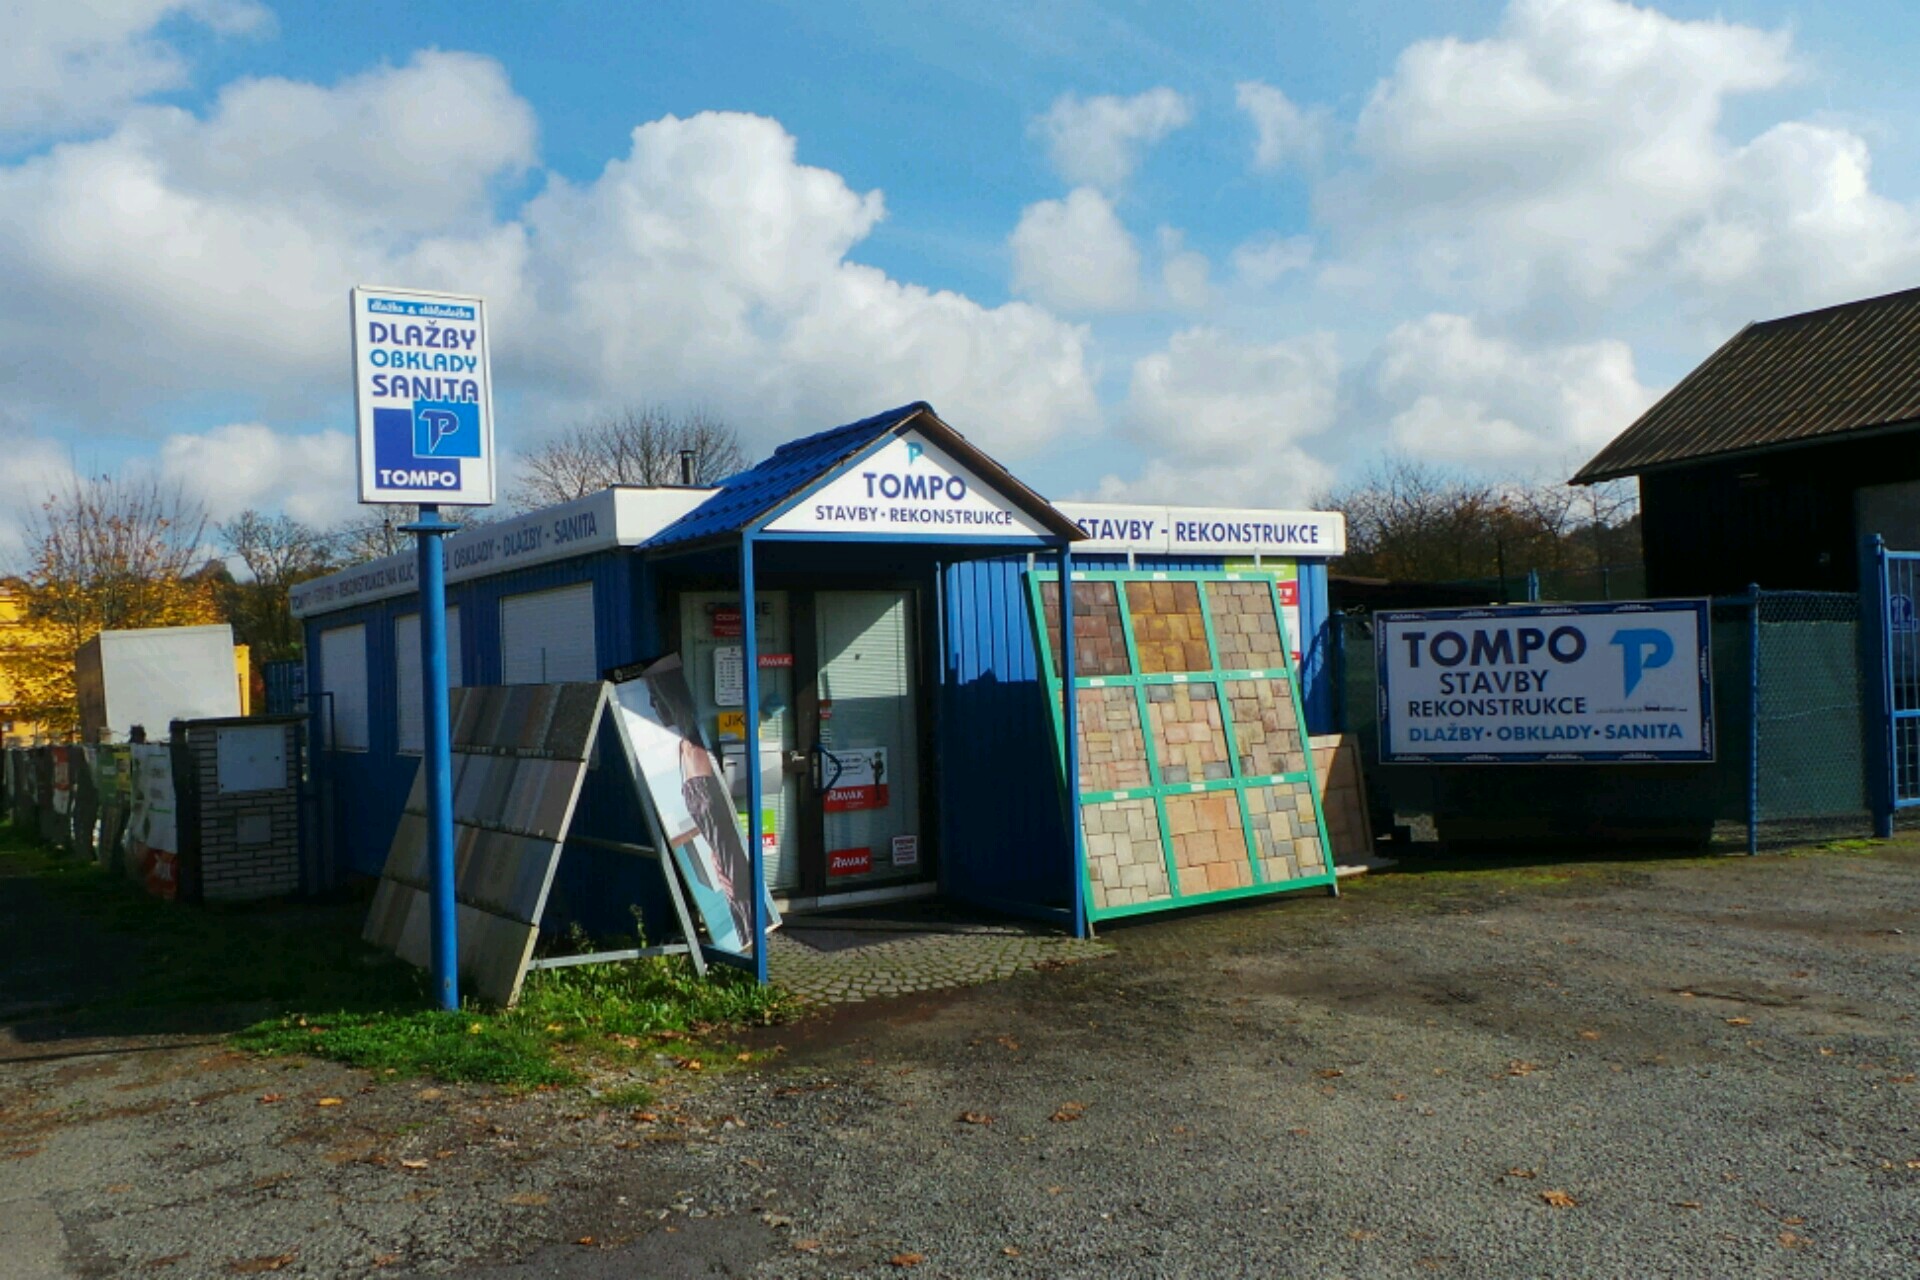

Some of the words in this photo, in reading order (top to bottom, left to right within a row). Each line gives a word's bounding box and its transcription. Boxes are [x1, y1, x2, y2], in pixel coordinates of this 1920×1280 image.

[369, 320, 476, 350] DLAŽBY
[370, 349, 477, 373] OBKLADY
[372, 374, 479, 402] SANITA
[381, 469, 457, 488] TOMPO
[863, 472, 967, 501] TOMPO
[815, 505, 879, 522] STAVBY
[890, 507, 1013, 525] REKONSTRUKCE
[503, 523, 543, 557] DLAŽBY
[554, 511, 597, 545] SANITA
[1077, 518, 1154, 541] STAVBY
[1176, 520, 1319, 544] REKONSTRUKCE
[1402, 625, 1587, 668] TOMPO
[1439, 669, 1550, 695] STAVBY
[1408, 697, 1586, 718] REKONSTRUKCE
[1409, 722, 1485, 743] DLAŽBY
[1496, 724, 1594, 743] OBKLADY
[1604, 723, 1683, 741] SANITA
[827, 789, 865, 803] RAVAK
[832, 855, 869, 870] RAVAK
